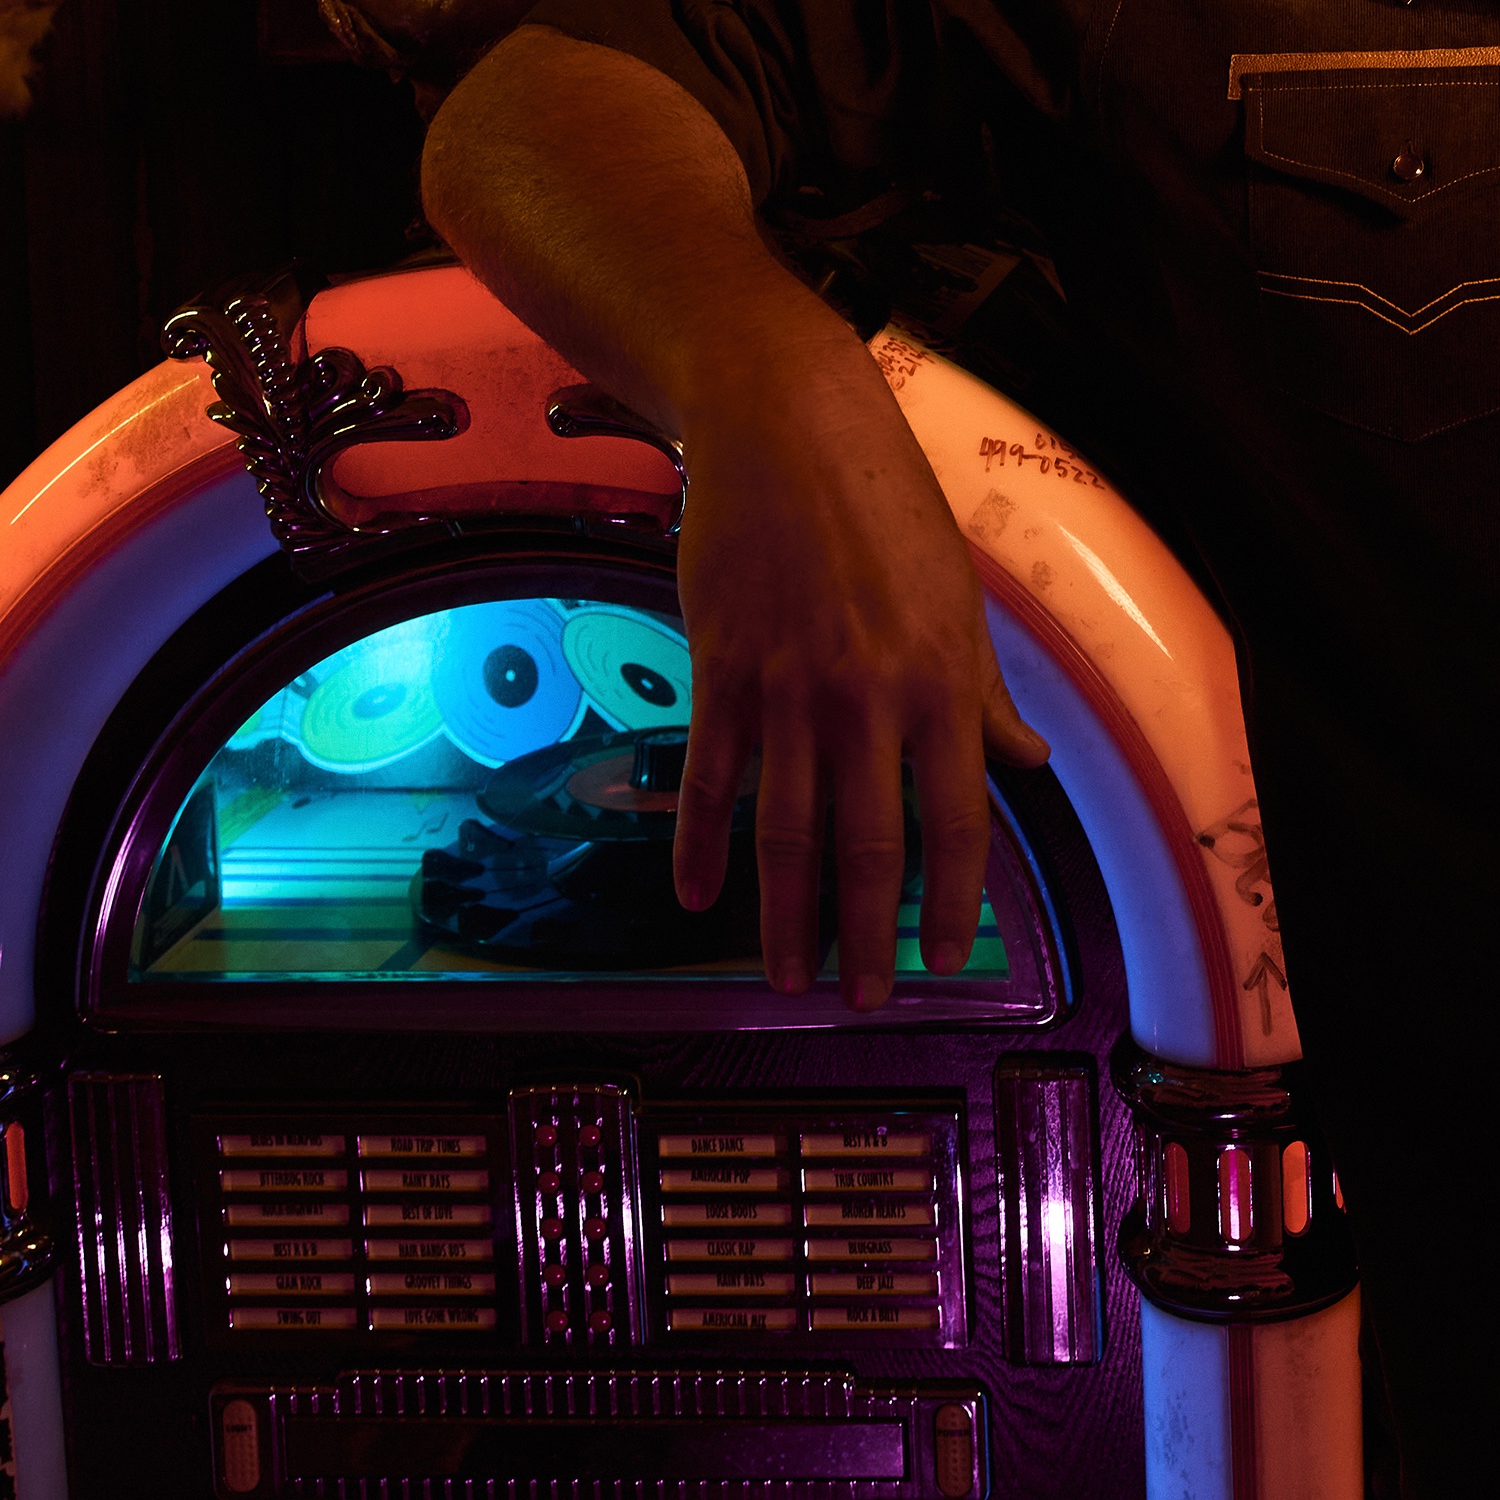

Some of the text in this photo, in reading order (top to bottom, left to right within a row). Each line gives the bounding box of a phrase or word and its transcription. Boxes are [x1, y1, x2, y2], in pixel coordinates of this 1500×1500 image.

[391, 1139, 461, 1153] ROAD TRIP TUNES
[691, 1138, 744, 1153] DANCE DANCE
[844, 1134, 861, 1147] BEST
[864, 1134, 870, 1147] R
[882, 1134, 888, 1146] B
[403, 1174, 451, 1188] RAINY DAYS
[691, 1169, 751, 1183] AMERICAN POP
[835, 1172, 894, 1187] TRUE COUNTRY
[402, 1206, 453, 1220] BEST OF LOVE
[706, 1205, 757, 1219] LOOSE BOOTS
[842, 1205, 906, 1218] BROKEN HEARTS
[274, 1243, 291, 1256] BEST
[399, 1244, 418, 1257] HAIR
[421, 1244, 446, 1257] BANDS
[708, 1242, 755, 1255] CLASSIC RAP
[848, 1242, 892, 1254] BLUEGRASS
[277, 1276, 321, 1289] GLAM ROCK
[444, 1276, 472, 1288] THINGS
[744, 1273, 765, 1287] DAYS
[857, 1276, 894, 1290] DEEP JAZZ
[278, 1311, 321, 1324] SWING OUT
[405, 1308, 479, 1323] LOVE GONE WRONG
[703, 1313, 767, 1330] AMERICANA MIX
[847, 1308, 869, 1322] ROCK
[871, 1309, 877, 1322] A
